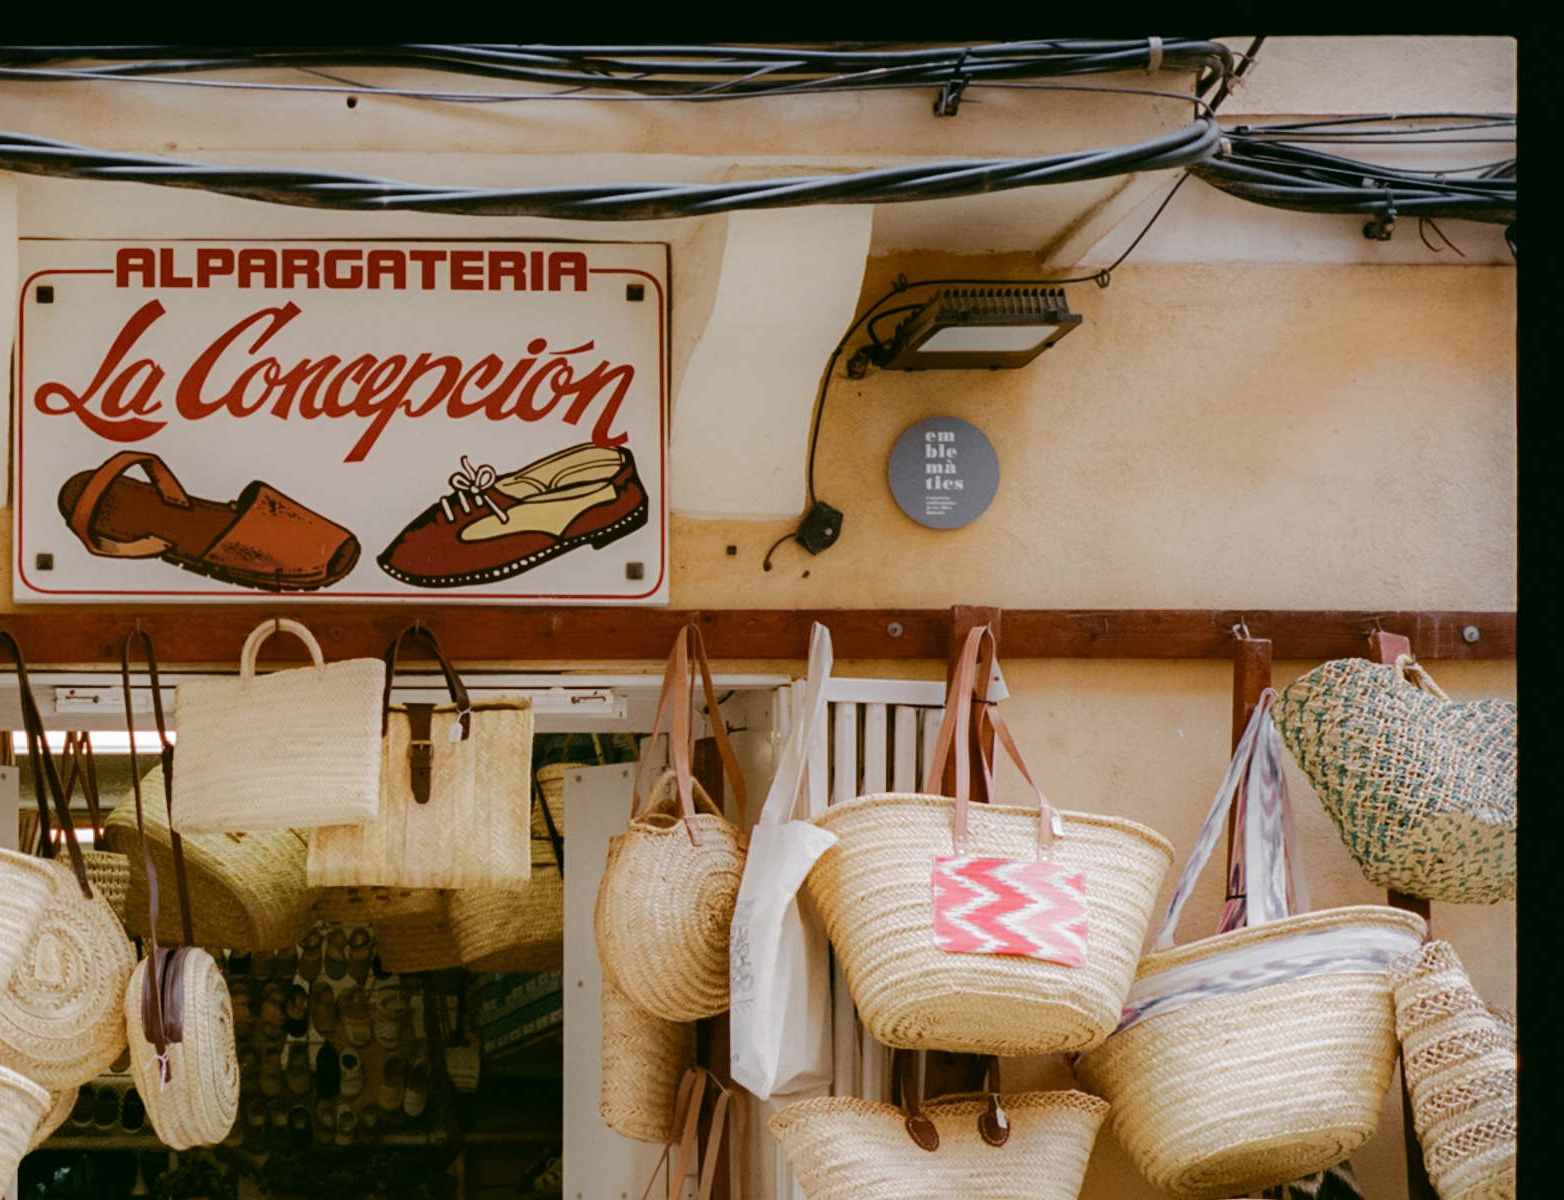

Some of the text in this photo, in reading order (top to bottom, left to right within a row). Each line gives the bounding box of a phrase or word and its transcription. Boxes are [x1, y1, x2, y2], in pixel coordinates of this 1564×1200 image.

[116, 248, 588, 292] ALPARGATERIA
[33, 299, 636, 462] La Concepción
[925, 431, 955, 442] em
[925, 443, 957, 458] ble
[925, 459, 957, 474] mà
